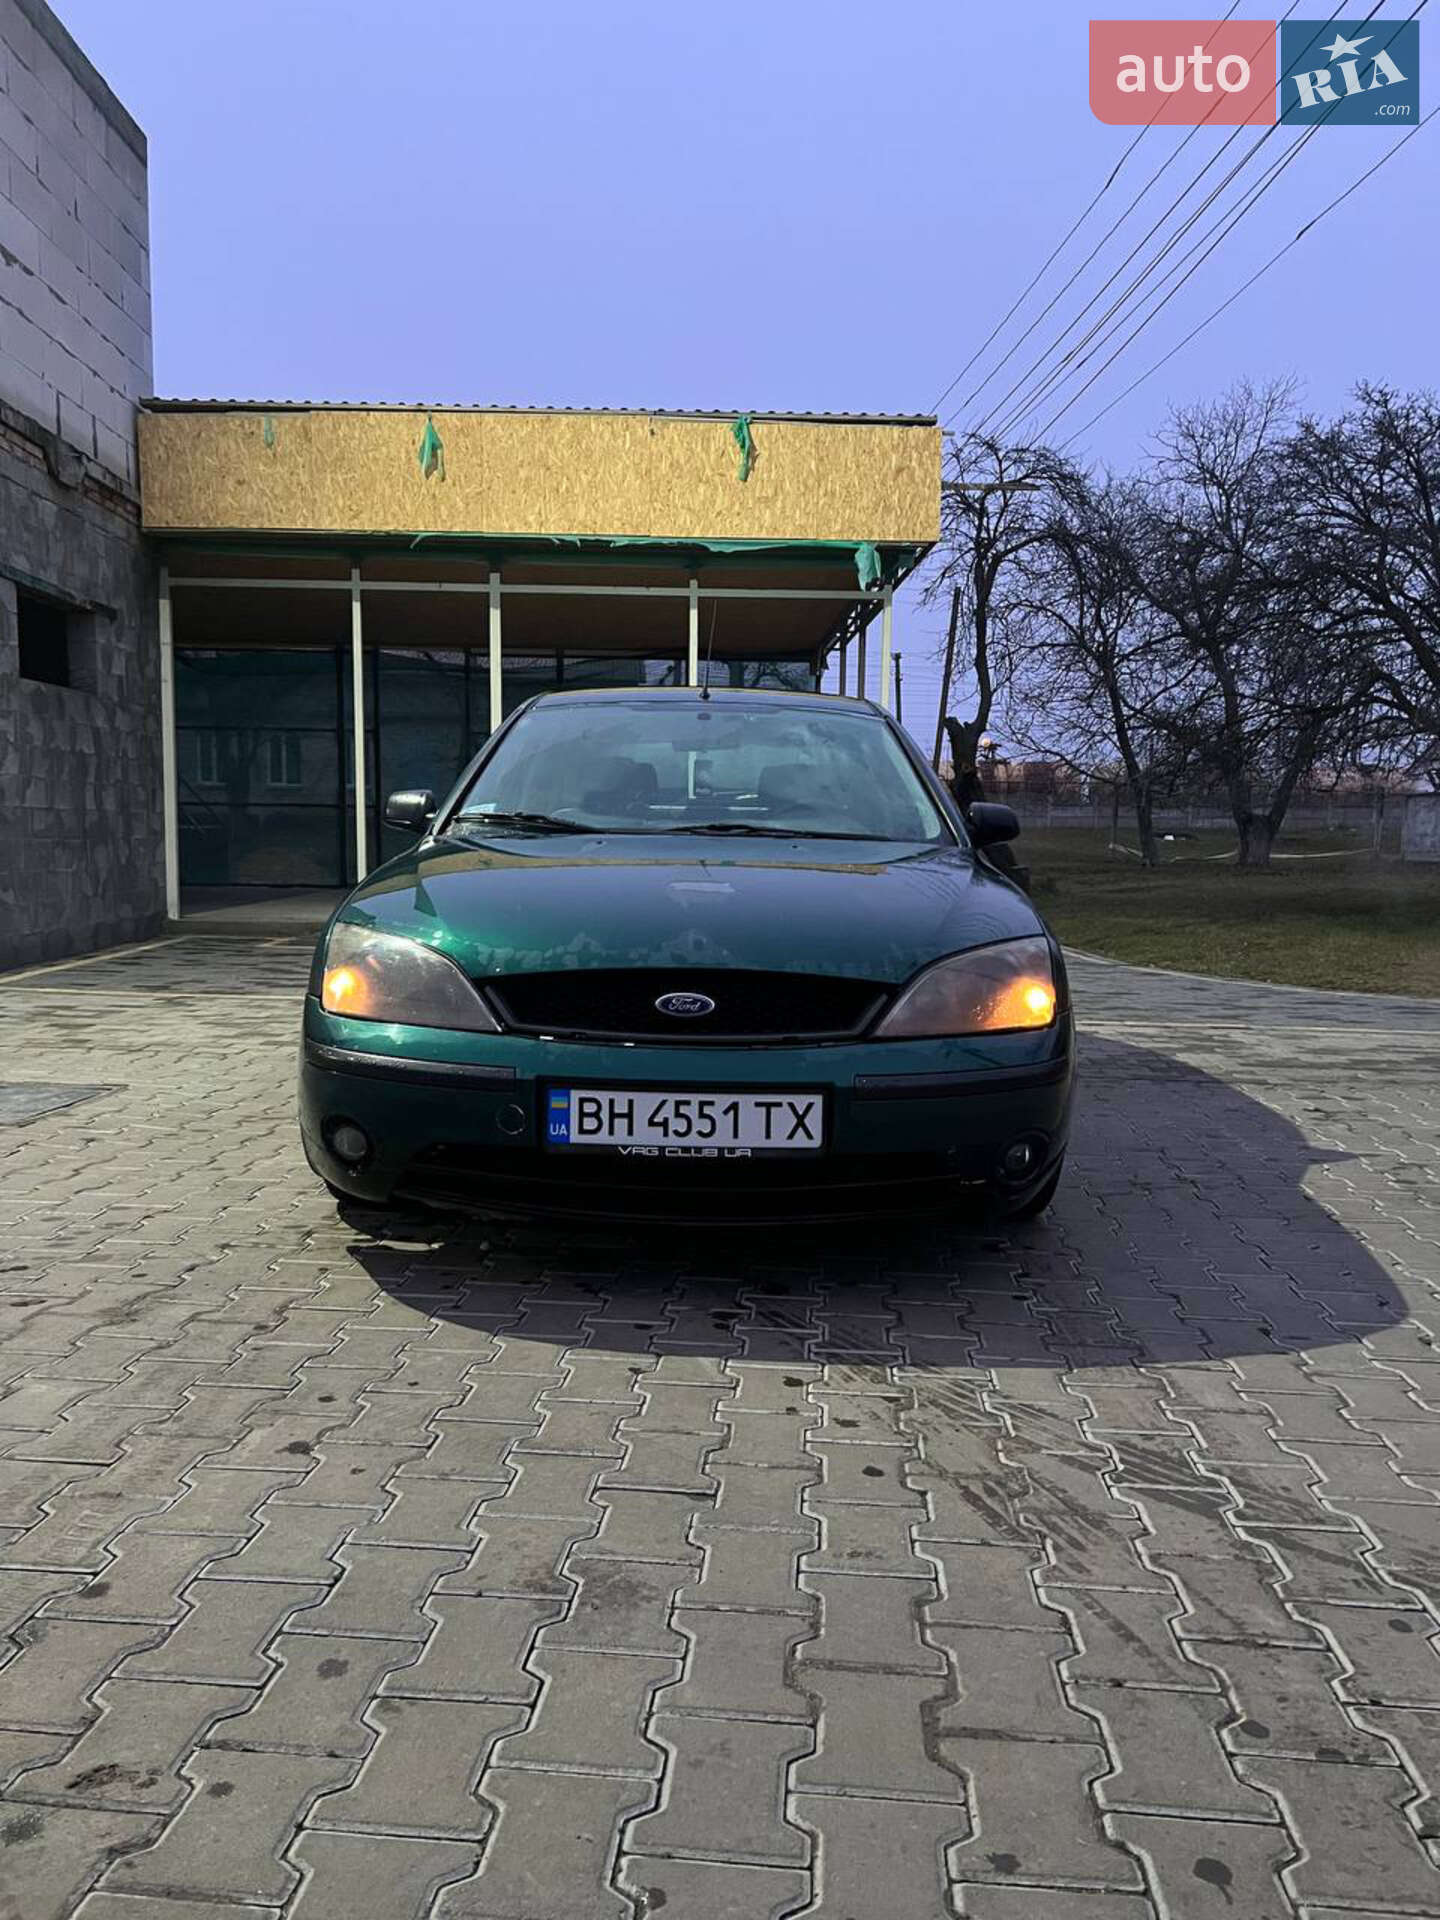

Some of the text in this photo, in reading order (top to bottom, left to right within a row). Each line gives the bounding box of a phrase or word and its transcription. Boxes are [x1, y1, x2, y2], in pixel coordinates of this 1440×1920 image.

[668, 996, 701, 1012] Ford
[550, 1096, 815, 1141] UA BH 4551 TX
[618, 1145, 752, 1158] VAG CLUB UA
